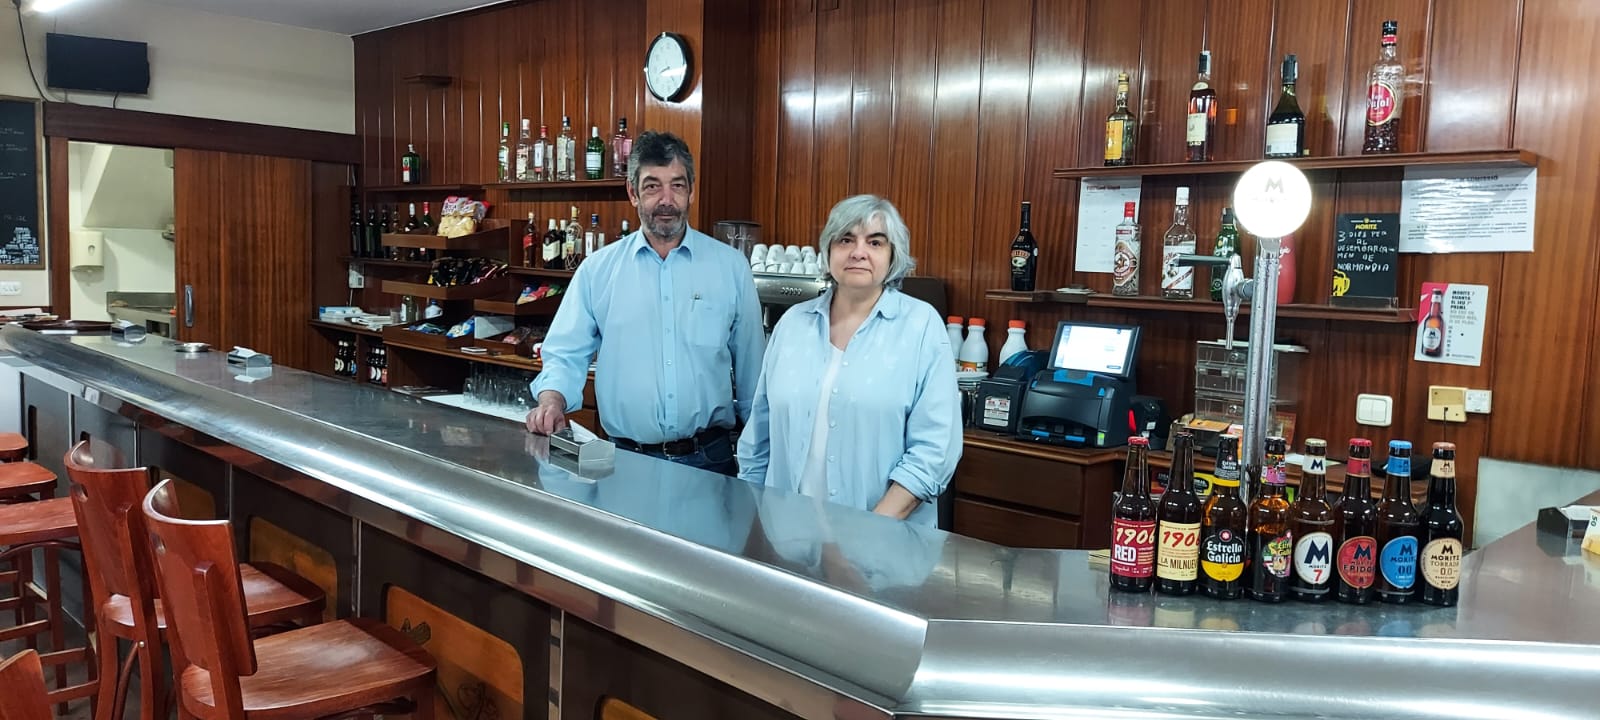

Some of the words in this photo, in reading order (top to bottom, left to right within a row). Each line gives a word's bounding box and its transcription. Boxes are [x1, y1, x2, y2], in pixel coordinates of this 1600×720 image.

[1265, 177, 1284, 194] M
[1310, 459, 1324, 471] M
[1206, 540, 1243, 553] Estrella
[1304, 539, 1330, 565] M
[1353, 544, 1372, 561] M
[1400, 543, 1413, 556] M
[1441, 544, 1454, 555] M
[1114, 544, 1137, 563] RED
[1207, 551, 1241, 564] Galicia
[1160, 557, 1169, 565] LA
[1313, 569, 1323, 582] 7
